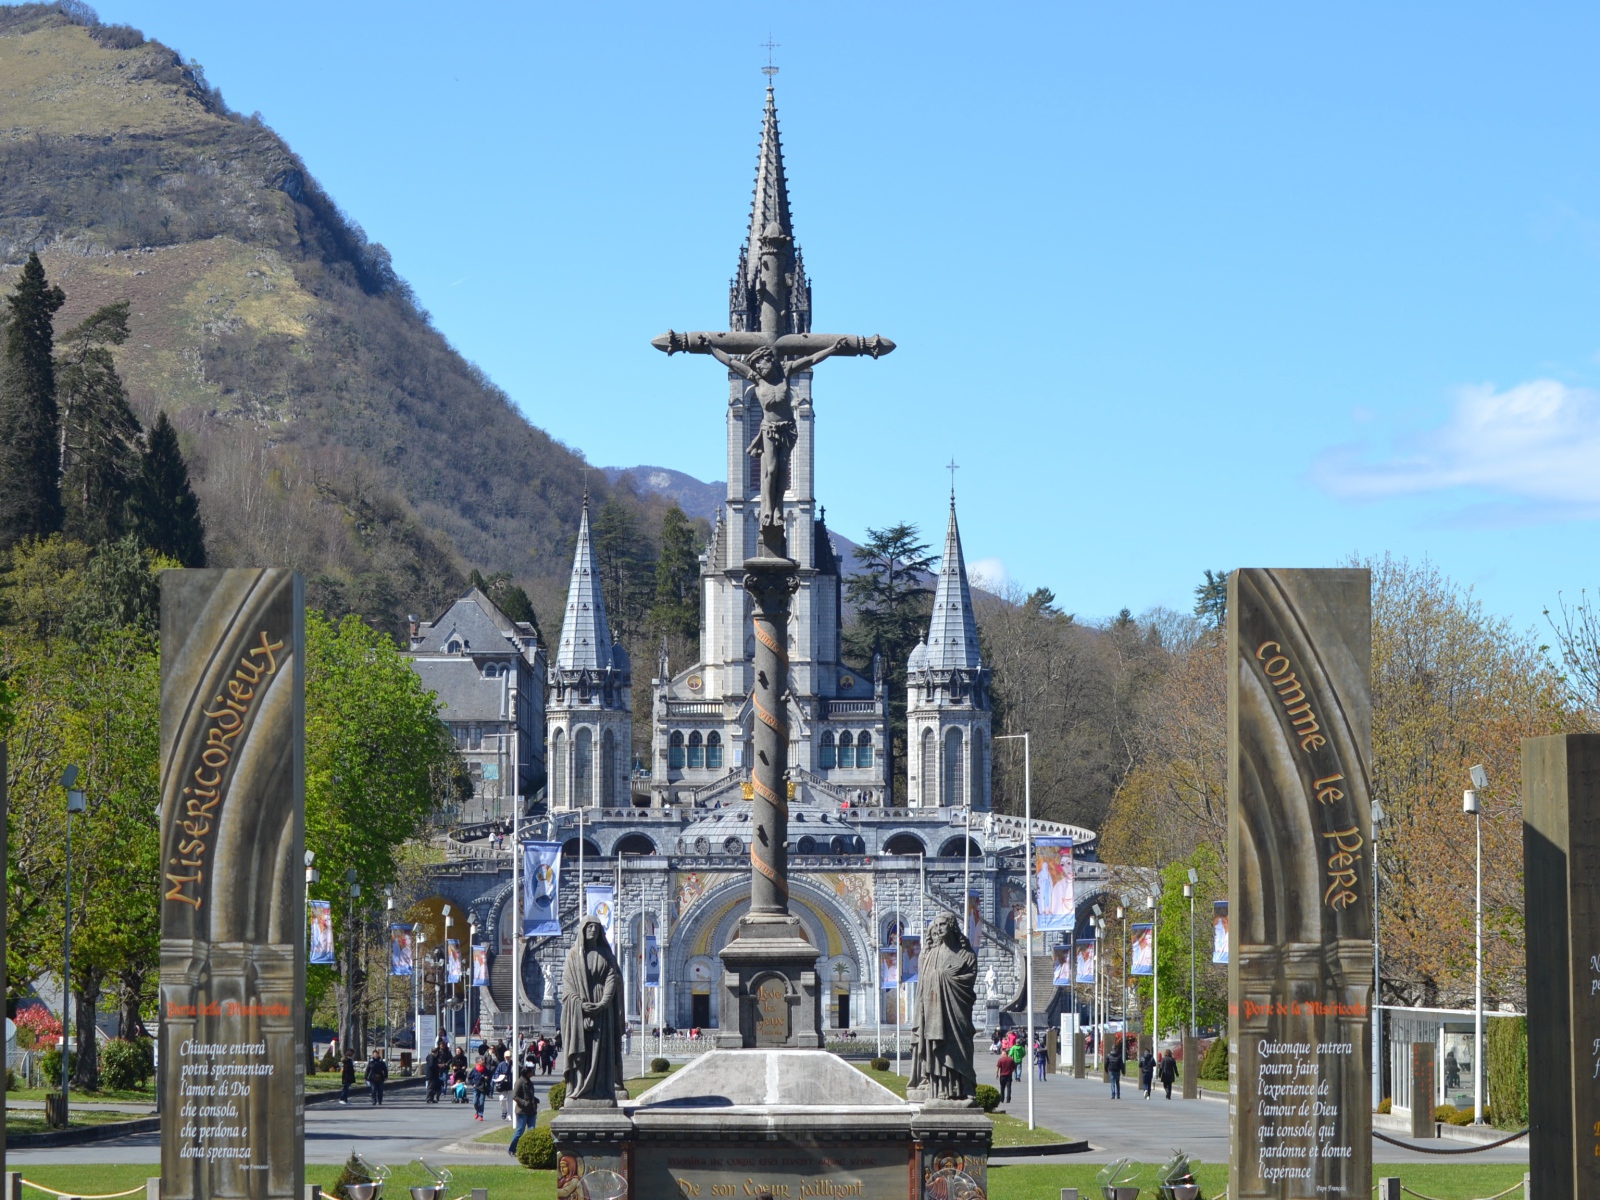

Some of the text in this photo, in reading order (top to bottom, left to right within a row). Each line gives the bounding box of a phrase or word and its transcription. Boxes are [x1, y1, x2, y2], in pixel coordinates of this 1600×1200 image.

[1313, 773, 1345, 805] le
[1243, 1001, 1273, 1019] Porte
[1276, 1001, 1289, 1016] de
[1291, 1000, 1301, 1016] la
[1305, 1000, 1369, 1016] Miséricorde
[180, 1038, 265, 1060] Chiunque entrerà
[1258, 1039, 1352, 1060] Quiconque entrera
[181, 1060, 274, 1080] potrà sperimentare
[1259, 1059, 1319, 1080] pourra faire
[180, 1079, 250, 1096] l'amore di Dio
[1317, 1079, 1329, 1096] de
[180, 1100, 239, 1119] che consola,
[1257, 1100, 1338, 1116] l'amour de Dieu
[180, 1120, 247, 1142] che perdona e
[1258, 1120, 1335, 1142] qui console, qui
[180, 1142, 251, 1163] dona speranza
[1259, 1142, 1352, 1163] pardonne et donne
[1257, 1162, 1311, 1184] l'espérance
[677, 1178, 701, 1198] De
[711, 1182, 737, 1197] son
